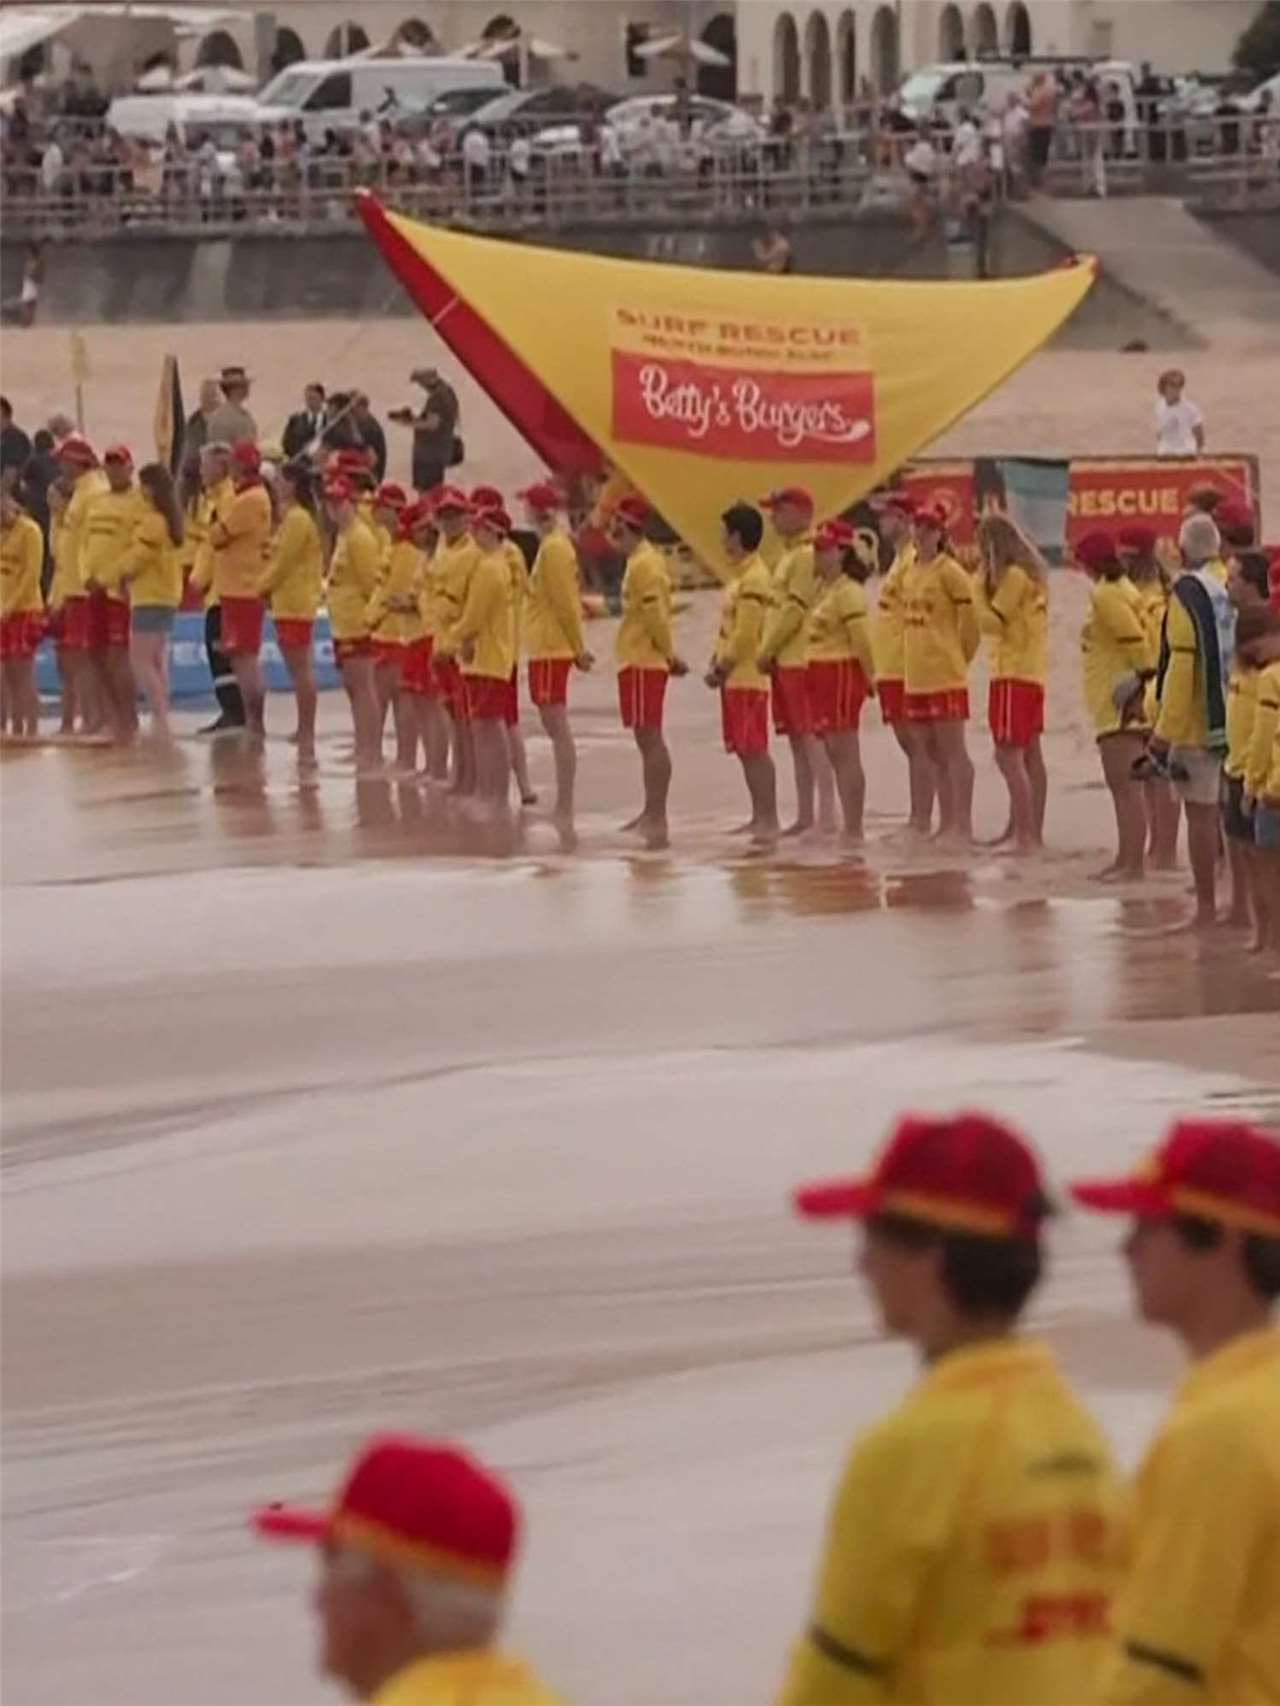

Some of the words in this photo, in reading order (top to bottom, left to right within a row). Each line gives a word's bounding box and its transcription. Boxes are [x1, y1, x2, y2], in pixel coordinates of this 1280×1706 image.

[617, 308, 706, 336] SURF
[719, 322, 859, 346] RESCUE
[640, 364, 731, 438] Betty's
[732, 379, 871, 447] Burgers
